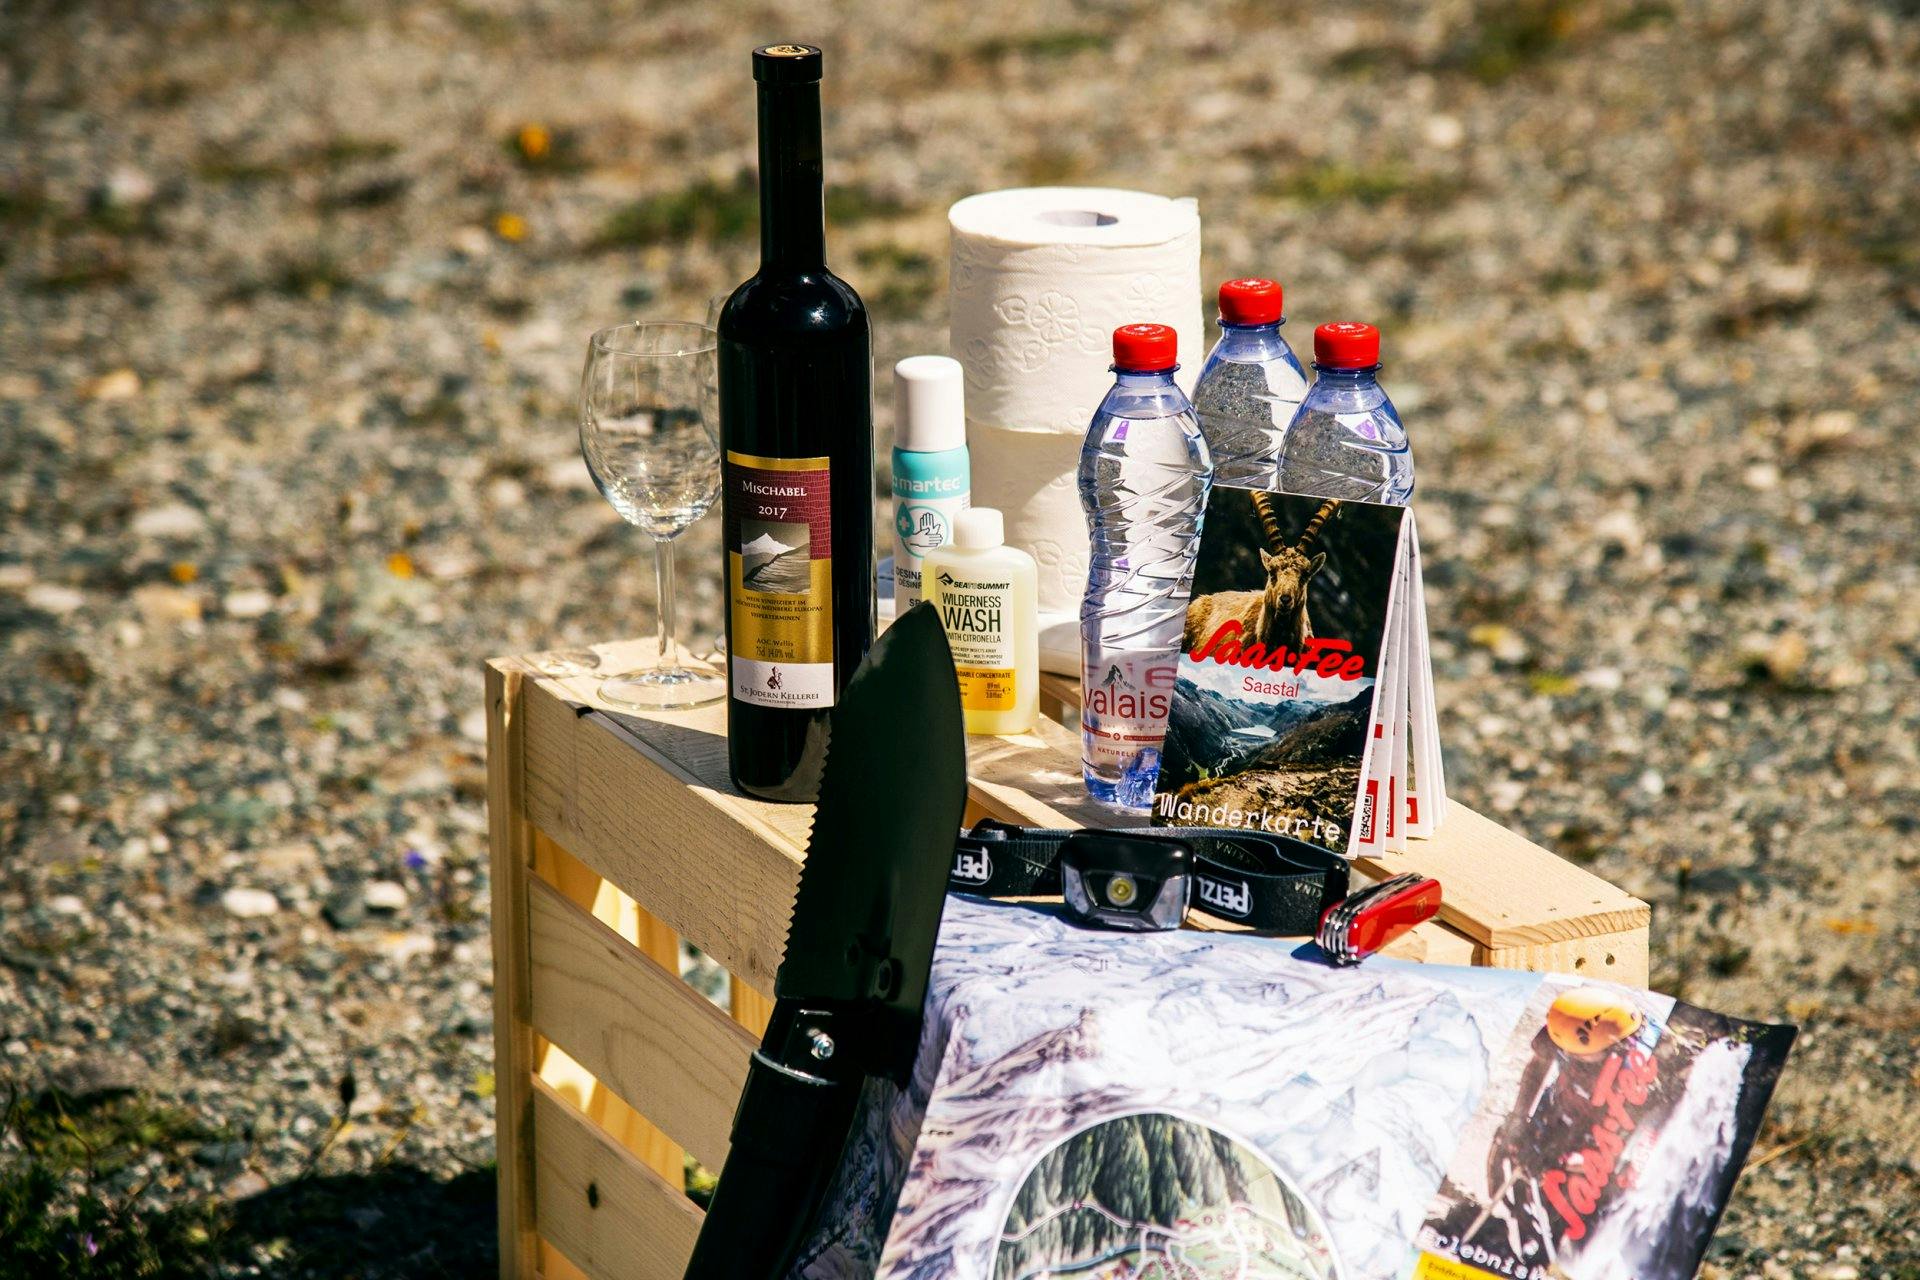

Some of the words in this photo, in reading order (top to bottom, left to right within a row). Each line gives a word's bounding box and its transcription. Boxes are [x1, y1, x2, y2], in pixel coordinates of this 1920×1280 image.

[899, 475, 961, 492] martec
[758, 505, 788, 520] 2017
[942, 592, 1002, 608] WILDERNESS
[943, 605, 1001, 633] WASH
[947, 632, 961, 642] WITH
[962, 633, 1001, 643] CITRONELLA
[780, 691, 819, 700] KELLEREI
[1242, 676, 1300, 699] Saastal
[1082, 683, 1168, 719] valais
[1157, 793, 1341, 843] Wanderkarte
[952, 846, 989, 881] PET
[1196, 876, 1249, 914] PETZL
